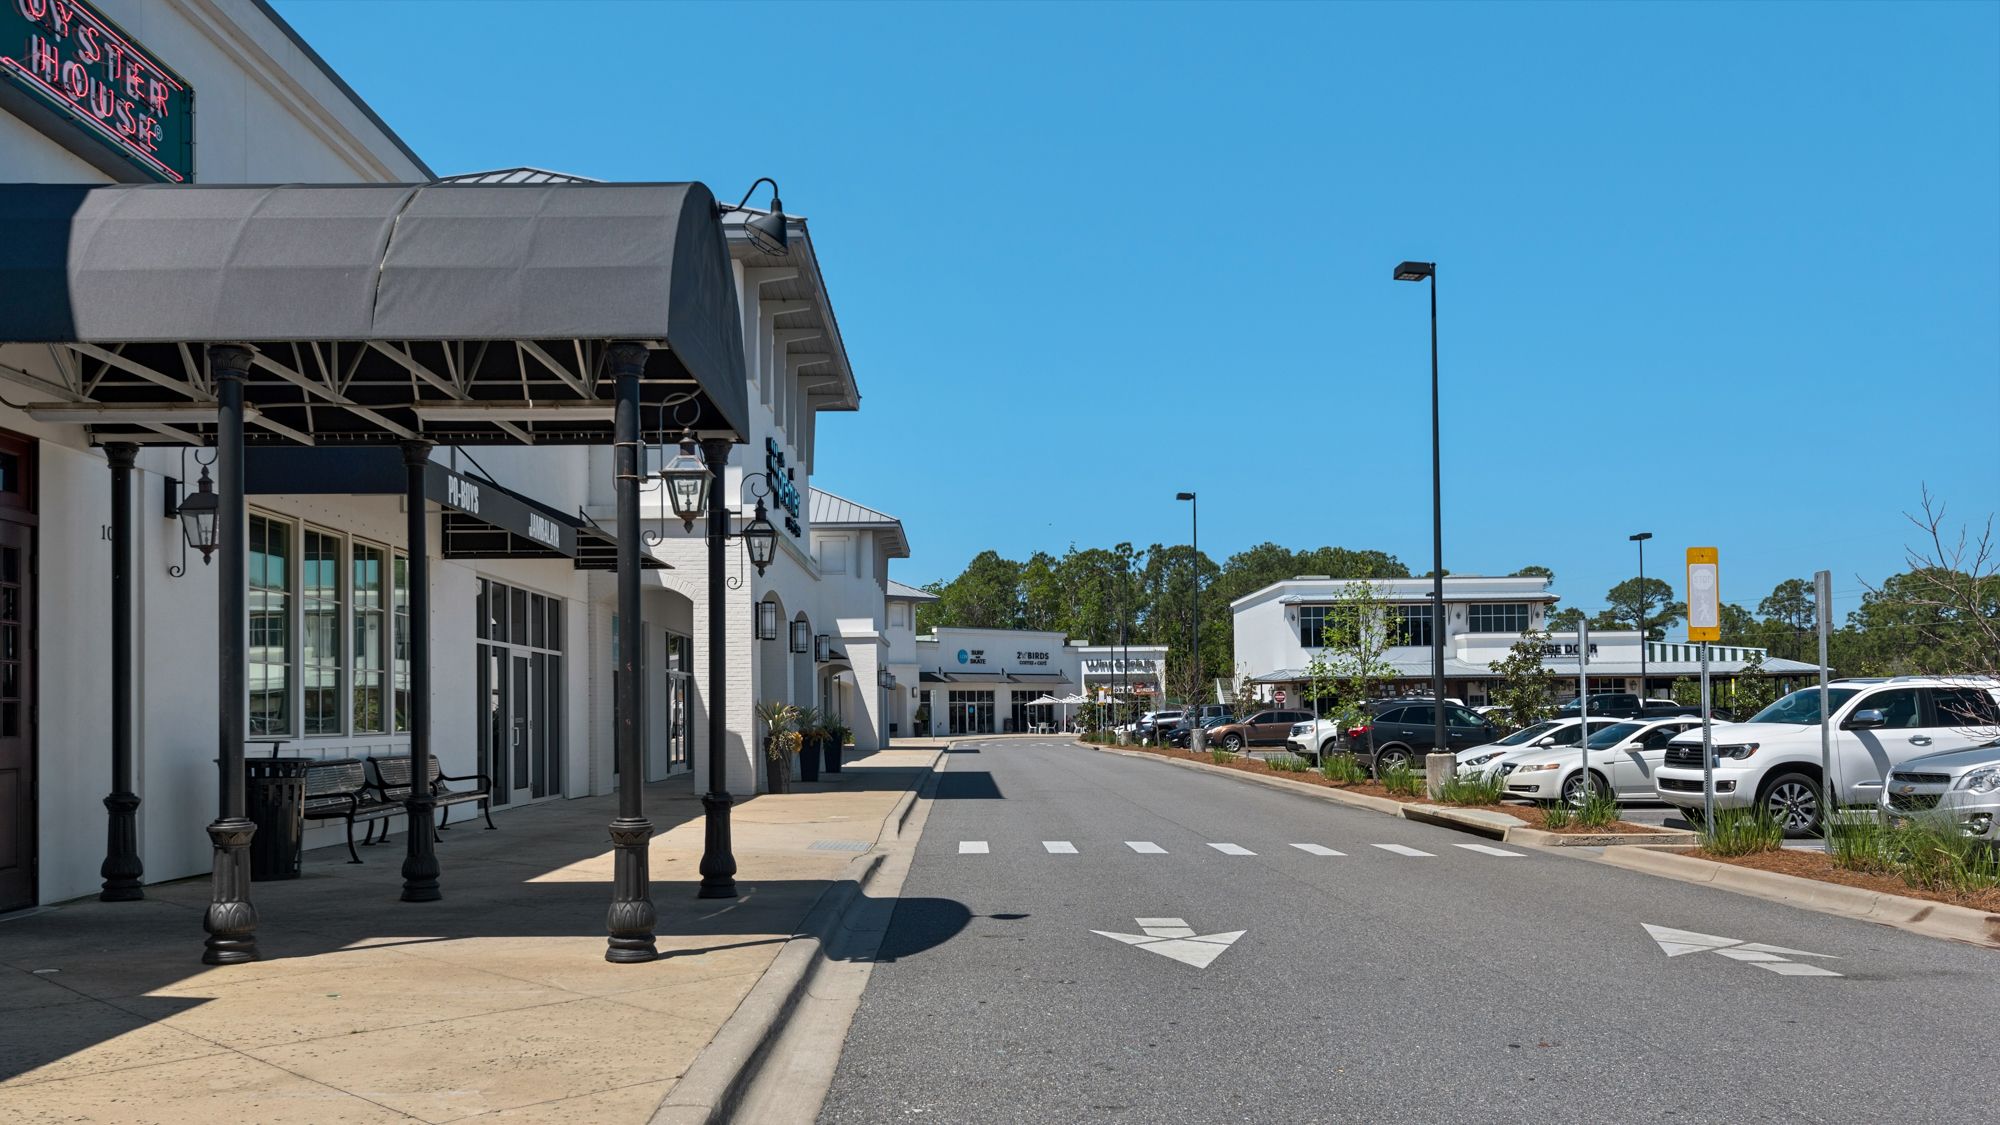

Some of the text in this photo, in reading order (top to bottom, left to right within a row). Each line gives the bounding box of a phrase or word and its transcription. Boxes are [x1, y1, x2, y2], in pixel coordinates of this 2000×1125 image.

[448, 475, 479, 514] PO-BOYS
[529, 512, 560, 549] JAMBALAYA
[1027, 652, 1050, 660] BIRDS
[1564, 644, 1598, 654] DOR
